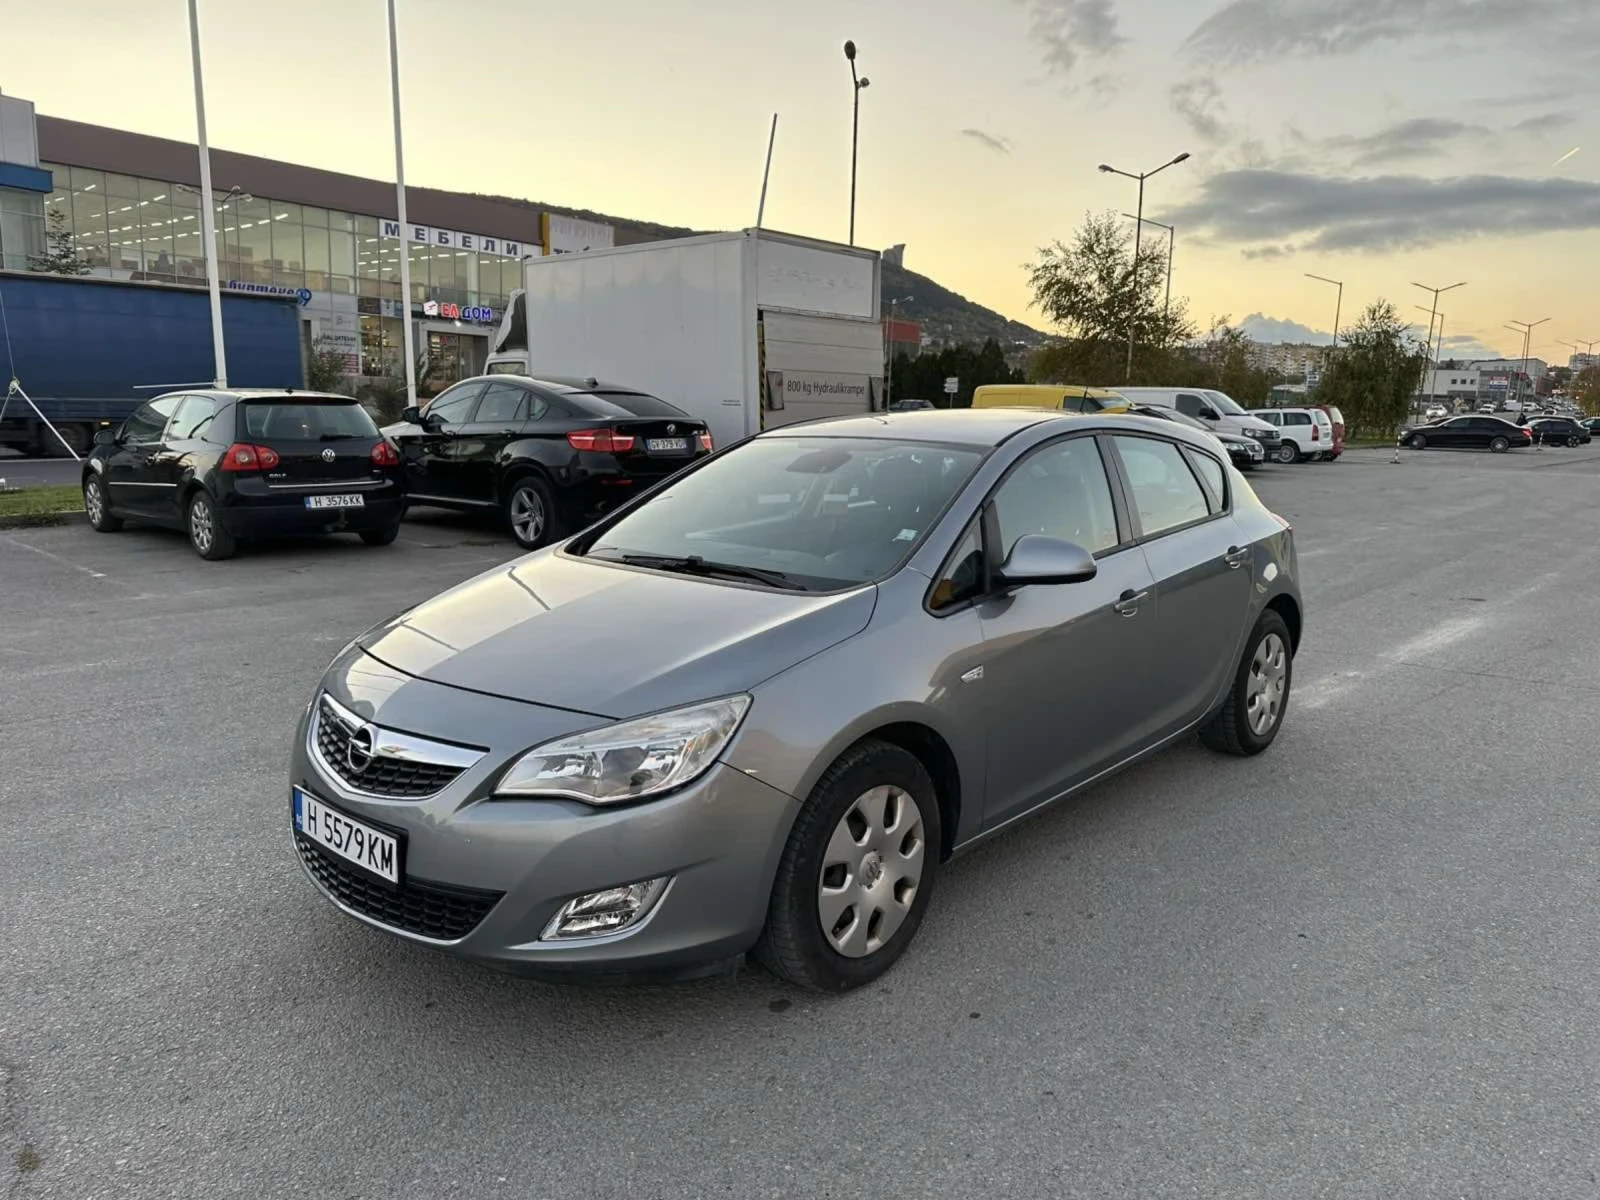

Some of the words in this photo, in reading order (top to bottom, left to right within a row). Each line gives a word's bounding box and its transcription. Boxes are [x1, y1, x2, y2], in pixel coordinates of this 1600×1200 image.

[384, 222, 518, 256] МЕБЕЛИ
[462, 306, 492, 320] ДОМ
[787, 380, 801, 392] 800
[802, 381, 812, 396] kg
[813, 381, 865, 397] Hydraulikrampe
[308, 801, 317, 836] H
